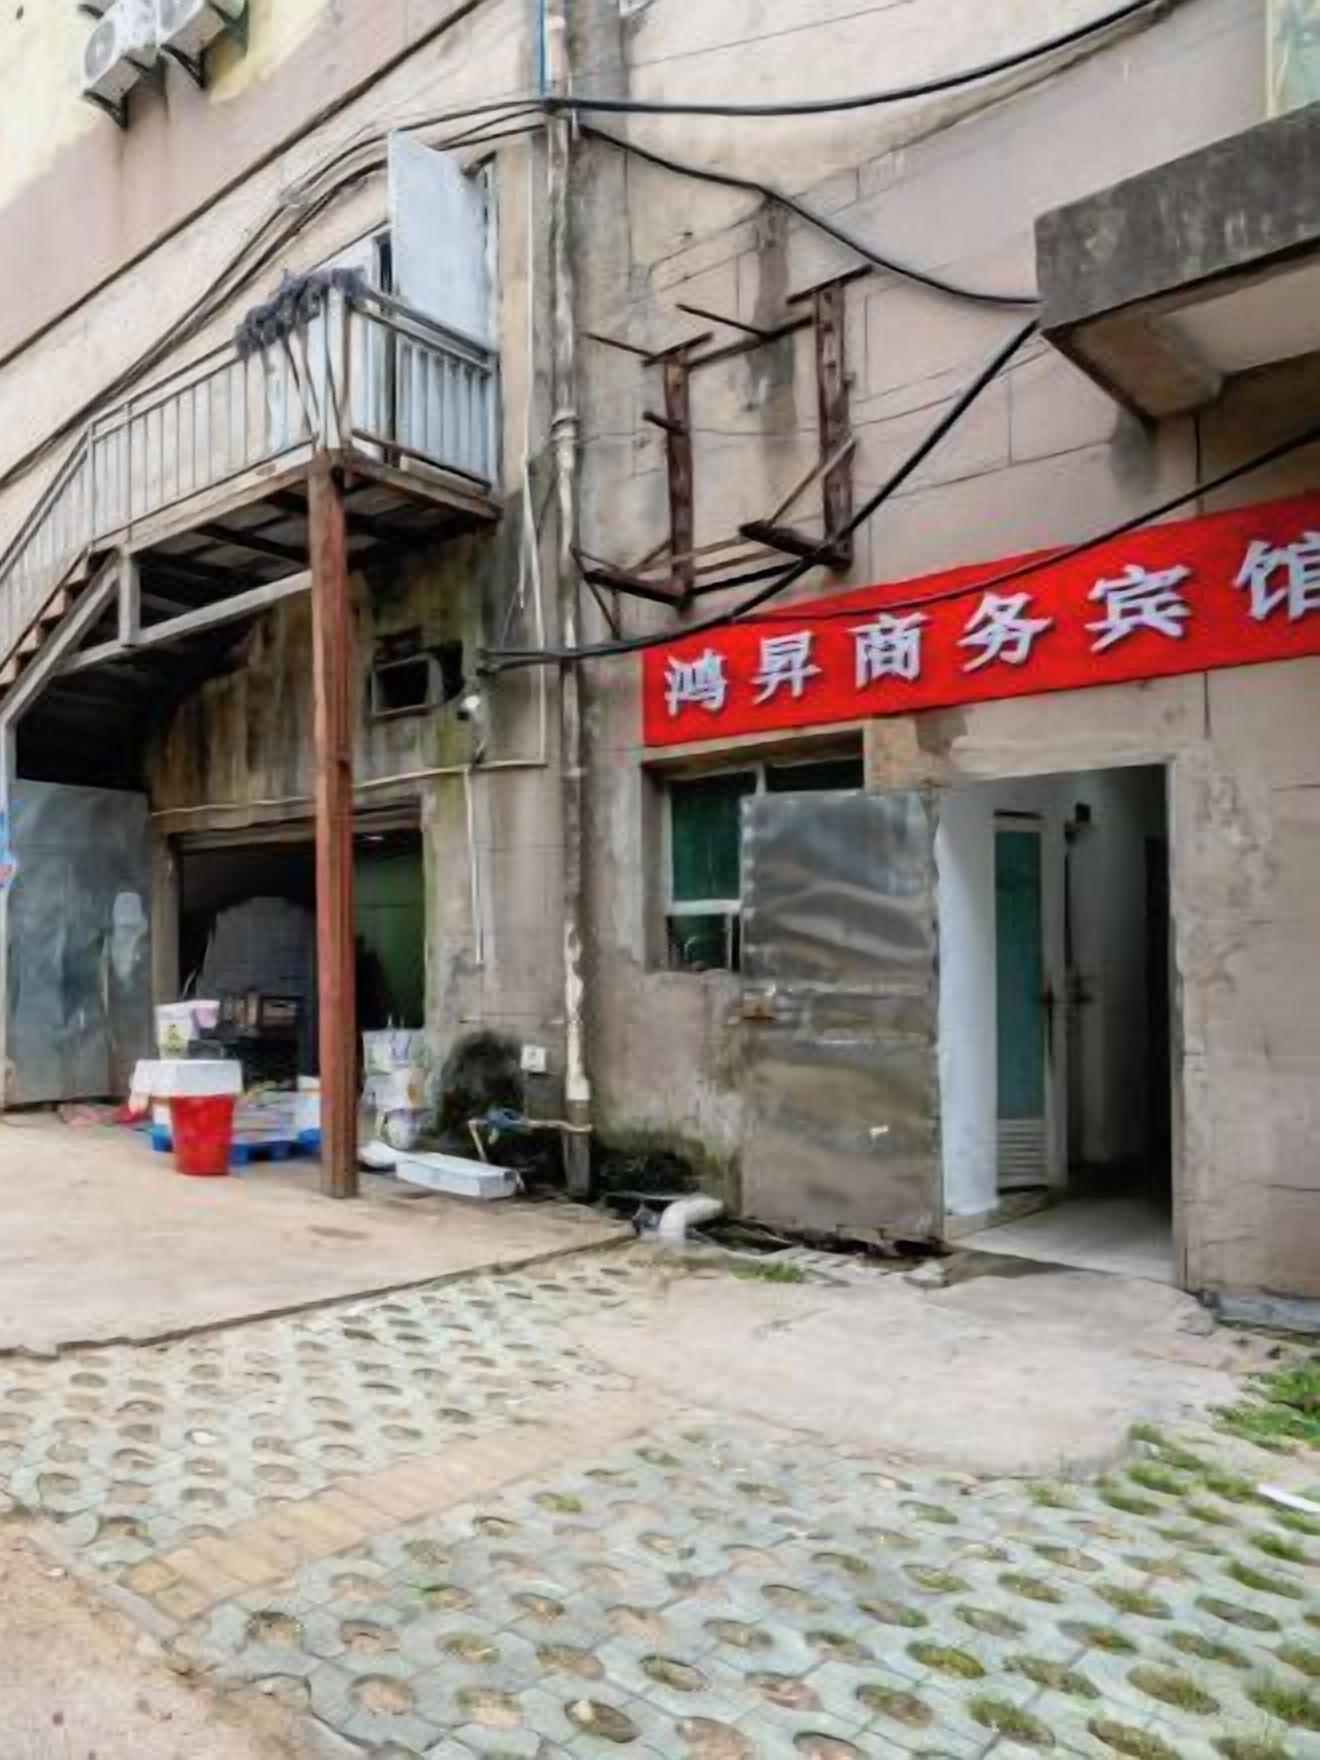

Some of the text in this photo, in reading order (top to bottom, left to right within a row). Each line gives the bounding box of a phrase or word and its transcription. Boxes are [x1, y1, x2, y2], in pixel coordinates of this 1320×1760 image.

[664, 530, 1320, 717] 鸿昇商务宾馆
